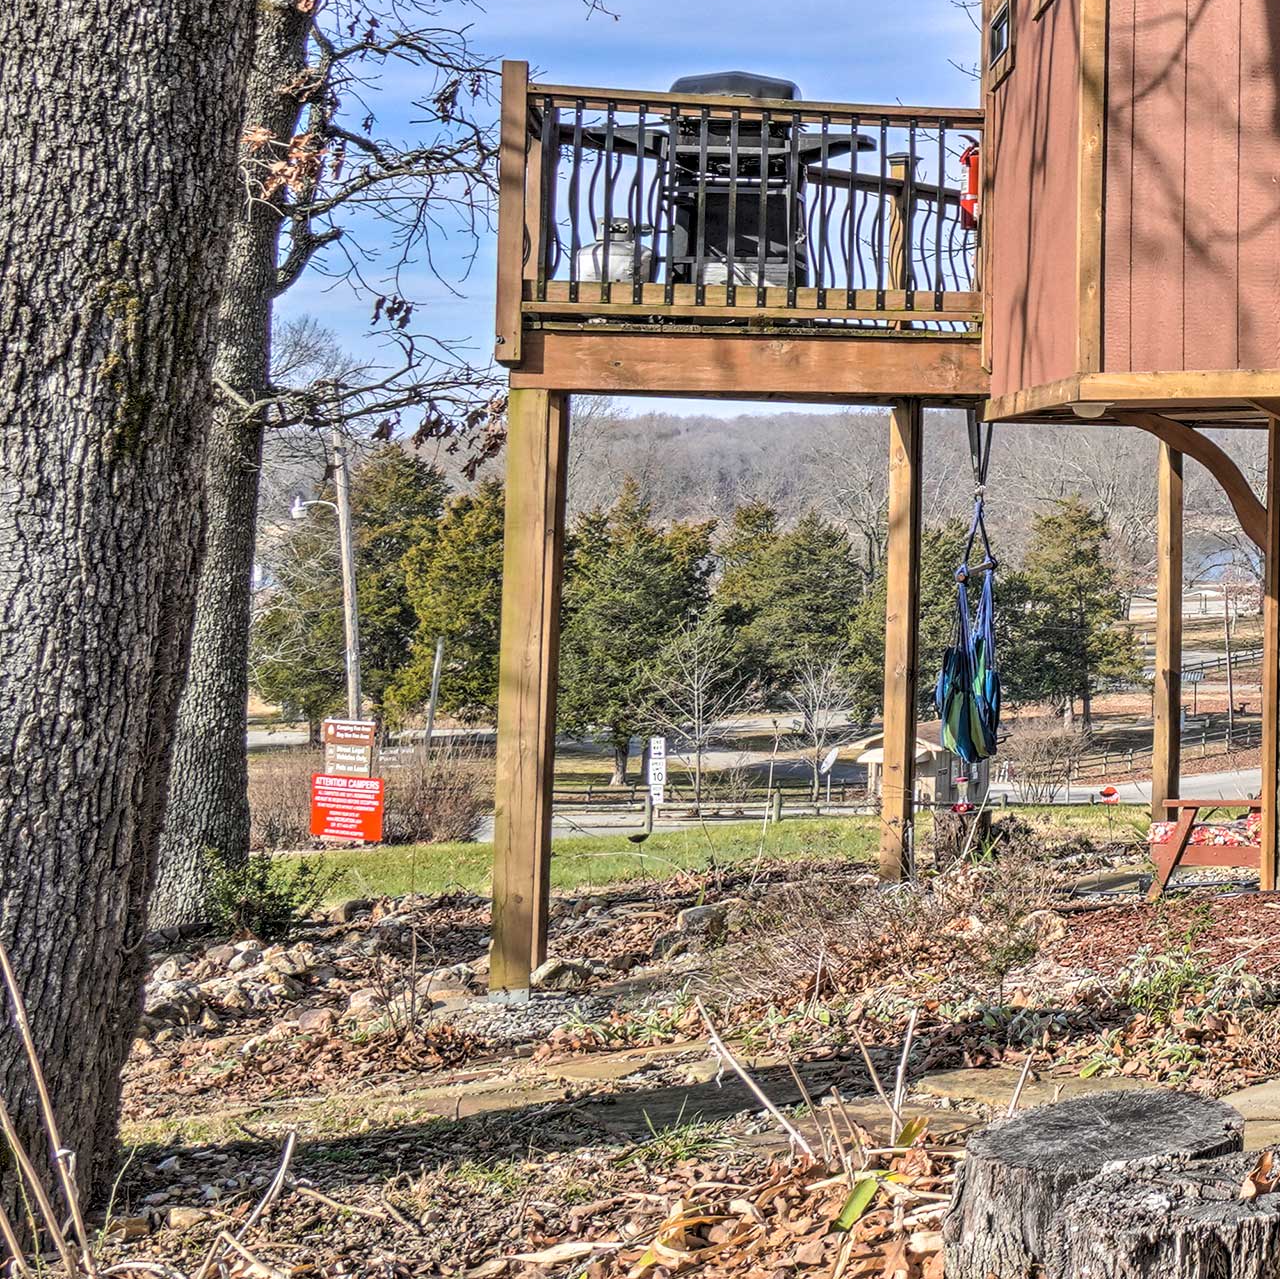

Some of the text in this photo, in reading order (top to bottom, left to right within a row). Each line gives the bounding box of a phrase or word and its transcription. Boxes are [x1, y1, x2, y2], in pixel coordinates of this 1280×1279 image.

[315, 776, 380, 790] ATTENTION CAMPERS
[653, 772, 664, 782] 10
